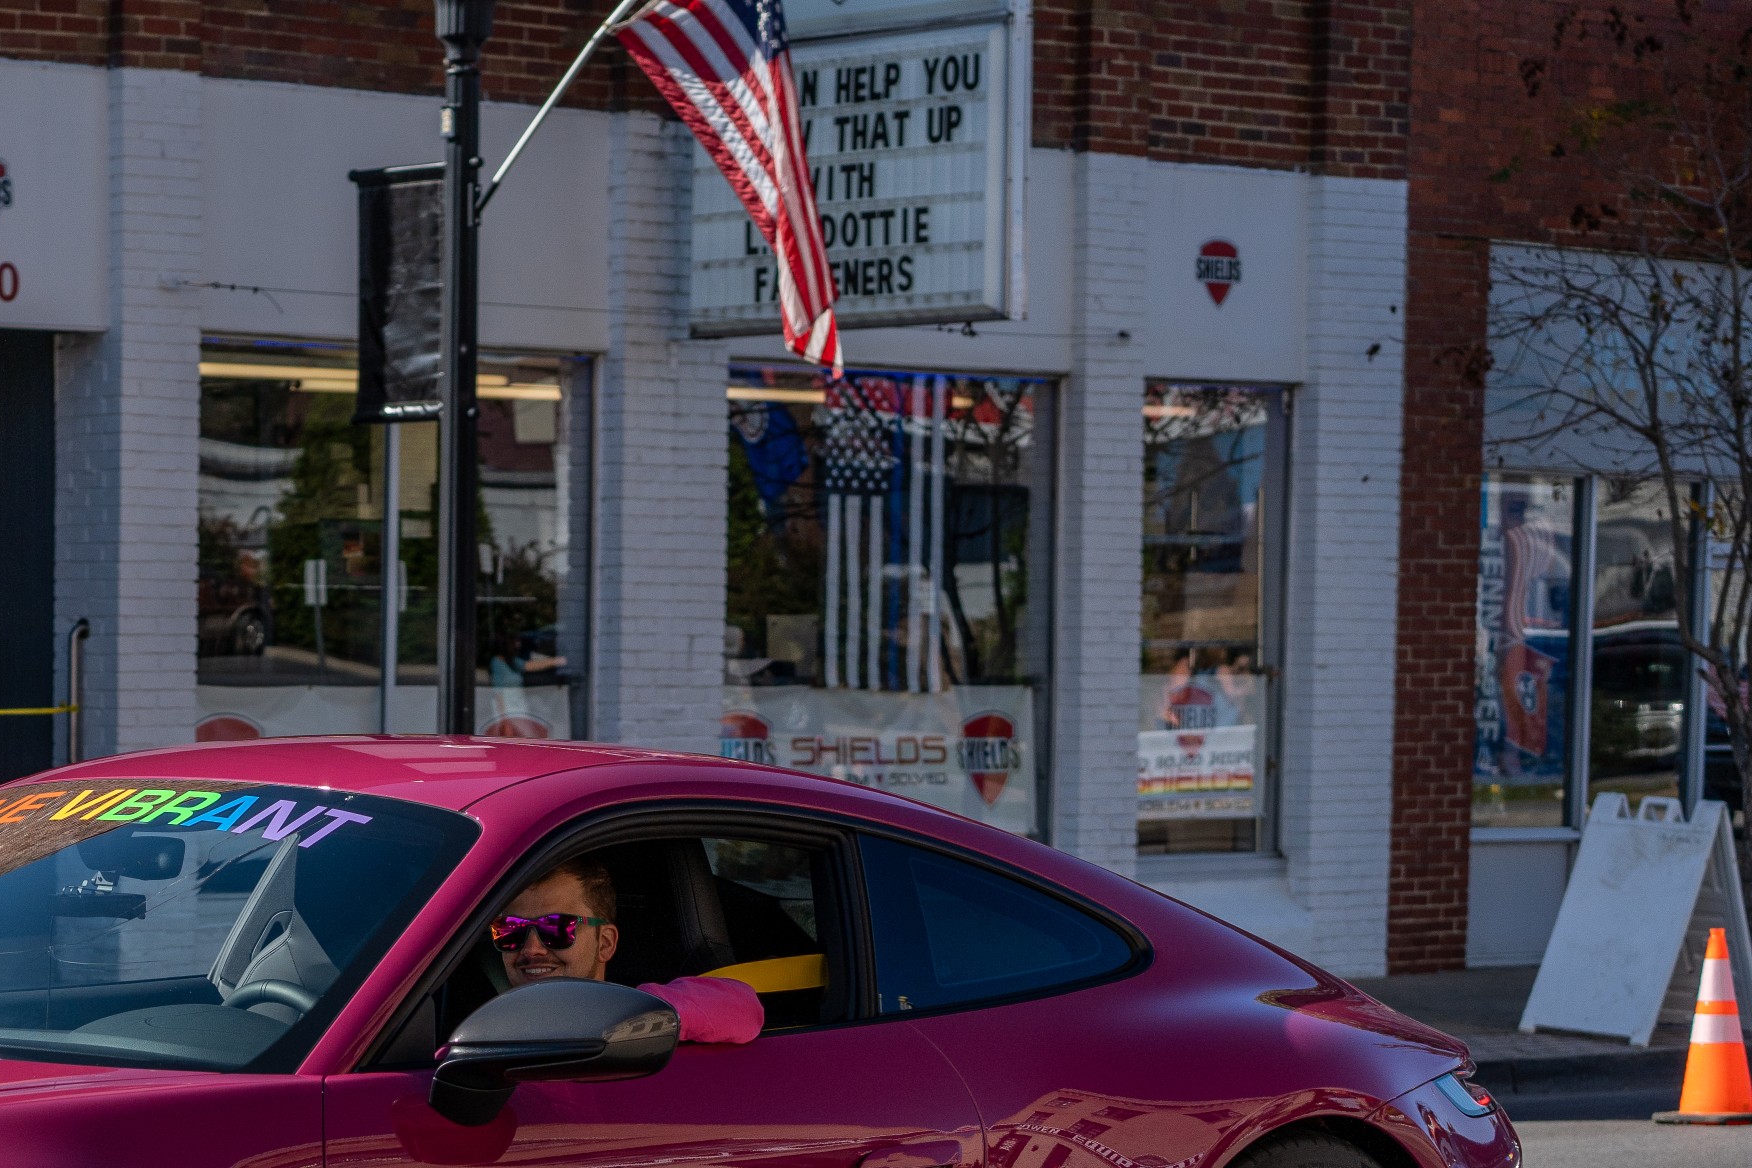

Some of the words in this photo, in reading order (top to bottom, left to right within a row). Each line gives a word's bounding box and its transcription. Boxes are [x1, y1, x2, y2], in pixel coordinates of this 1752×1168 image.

[835, 63, 900, 105] HELP
[923, 53, 980, 94] YOU
[834, 111, 910, 151] THAT
[927, 106, 962, 143] UP
[821, 206, 930, 249] DOTTIE
[1195, 256, 1242, 283] SHIELDS
[790, 736, 947, 767] SHIELDS
[956, 739, 1022, 770] SHIELDS
[49, 788, 374, 849] VIBRANT
